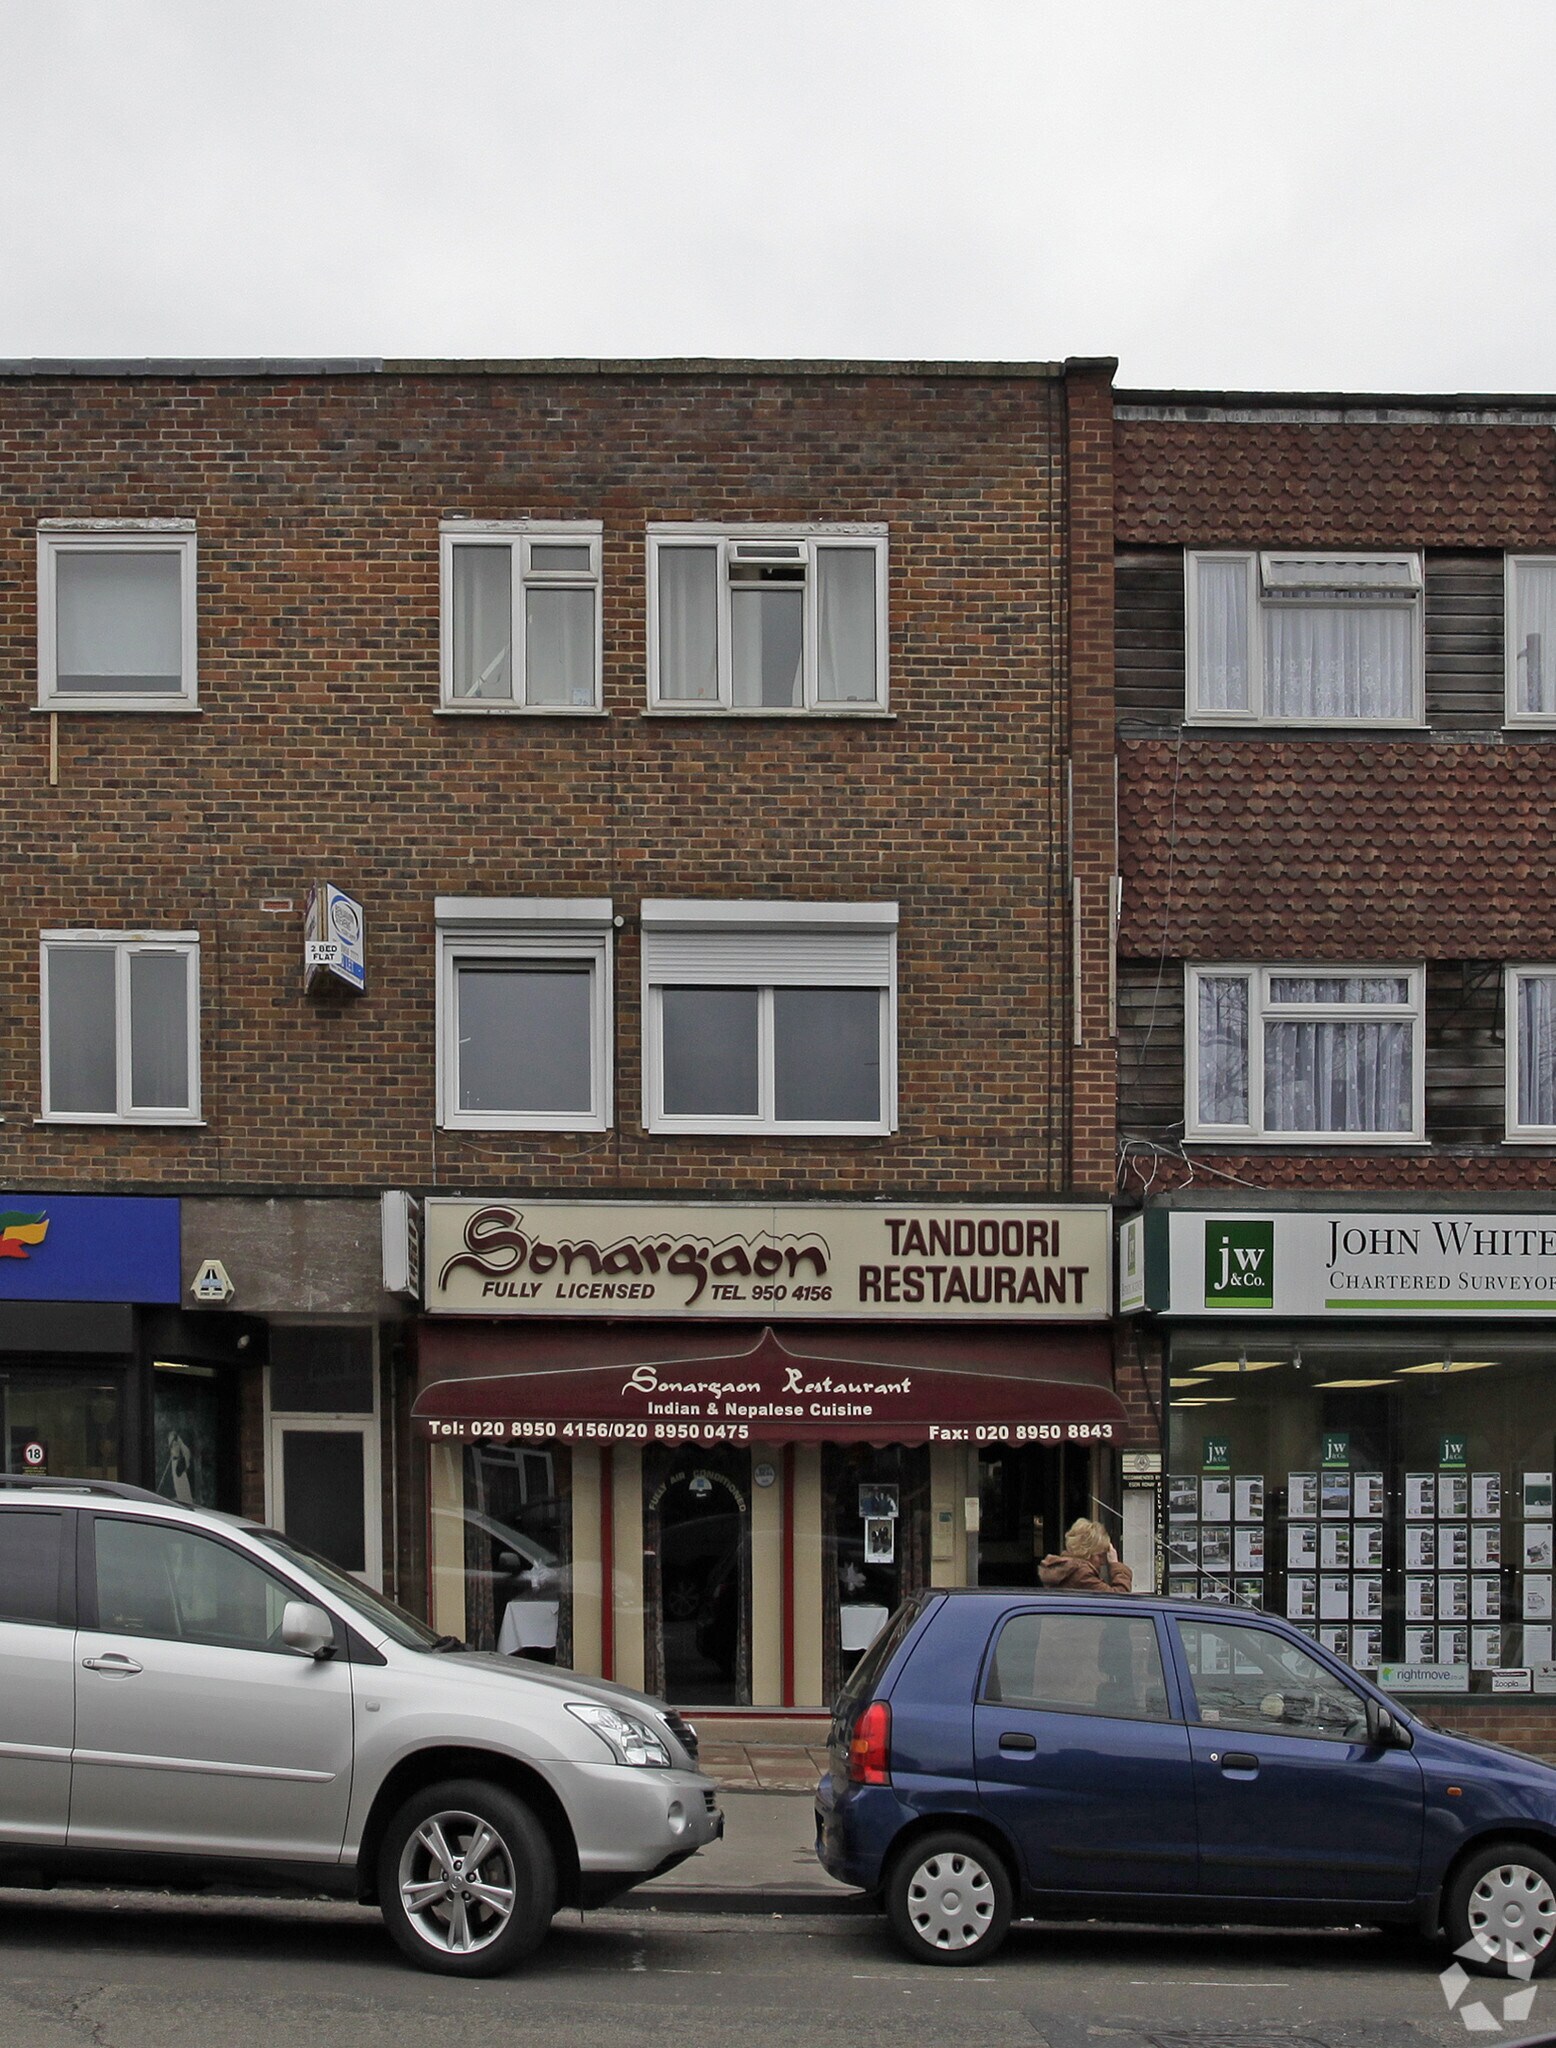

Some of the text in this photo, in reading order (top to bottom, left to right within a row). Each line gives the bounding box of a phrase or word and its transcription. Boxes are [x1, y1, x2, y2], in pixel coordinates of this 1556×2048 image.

[311, 945, 316, 953] 2
[318, 945, 338, 953] BED
[313, 953, 335, 961] FLAT
[884, 1218, 1060, 1257] TANDOORI
[1325, 1220, 1556, 1269] JOHN WHITE
[438, 1205, 830, 1306] Sonargaon
[1213, 1236, 1266, 1291] jw
[858, 1264, 1090, 1304] RESTAURANT
[1329, 1270, 1451, 1290] CHARTERED
[482, 1281, 656, 1300] FULLY LICENSED
[711, 1284, 833, 1302] TEL. 950 4156
[621, 1365, 912, 1399] Sonargaon Restaurant
[647, 1402, 873, 1418] Indian & Nepalese Cuisine
[429, 1420, 749, 1439] Tel: 020 8950 4156/020 8950 0475
[928, 1424, 1113, 1441] Fax: 020 8950 8843
[27, 1448, 41, 1459] 18
[648, 1482, 668, 1511] FULLY
[670, 1471, 686, 1485] AIR
[693, 1468, 747, 1512] CONDITIONED
